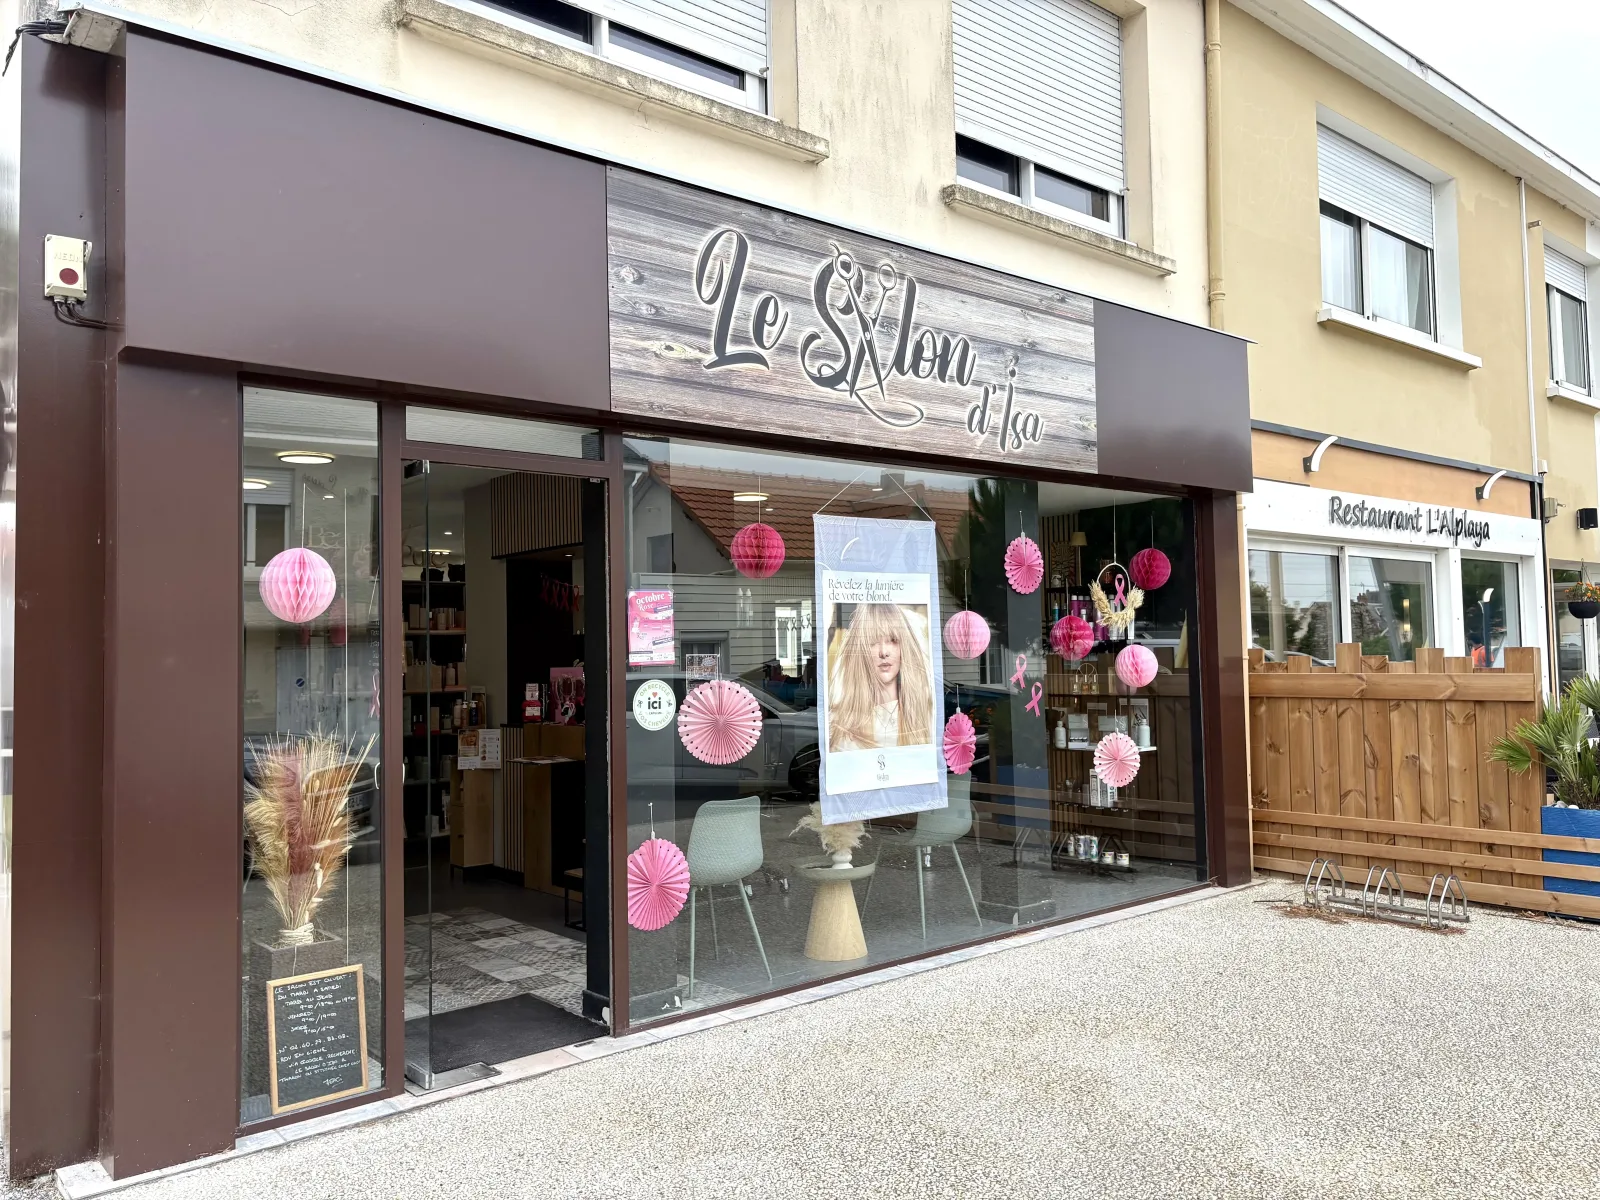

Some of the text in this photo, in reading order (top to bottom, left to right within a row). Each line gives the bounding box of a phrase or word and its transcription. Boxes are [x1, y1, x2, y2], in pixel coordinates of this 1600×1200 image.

[695, 229, 788, 371] Le
[1328, 495, 1490, 548] Restaurant L'Alplaya
[828, 578, 863, 590] Révélez
[865, 579, 873, 590] la
[636, 593, 665, 605] octobre
[828, 589, 840, 601] de
[842, 591, 864, 601] votre
[648, 697, 662, 710] ici
